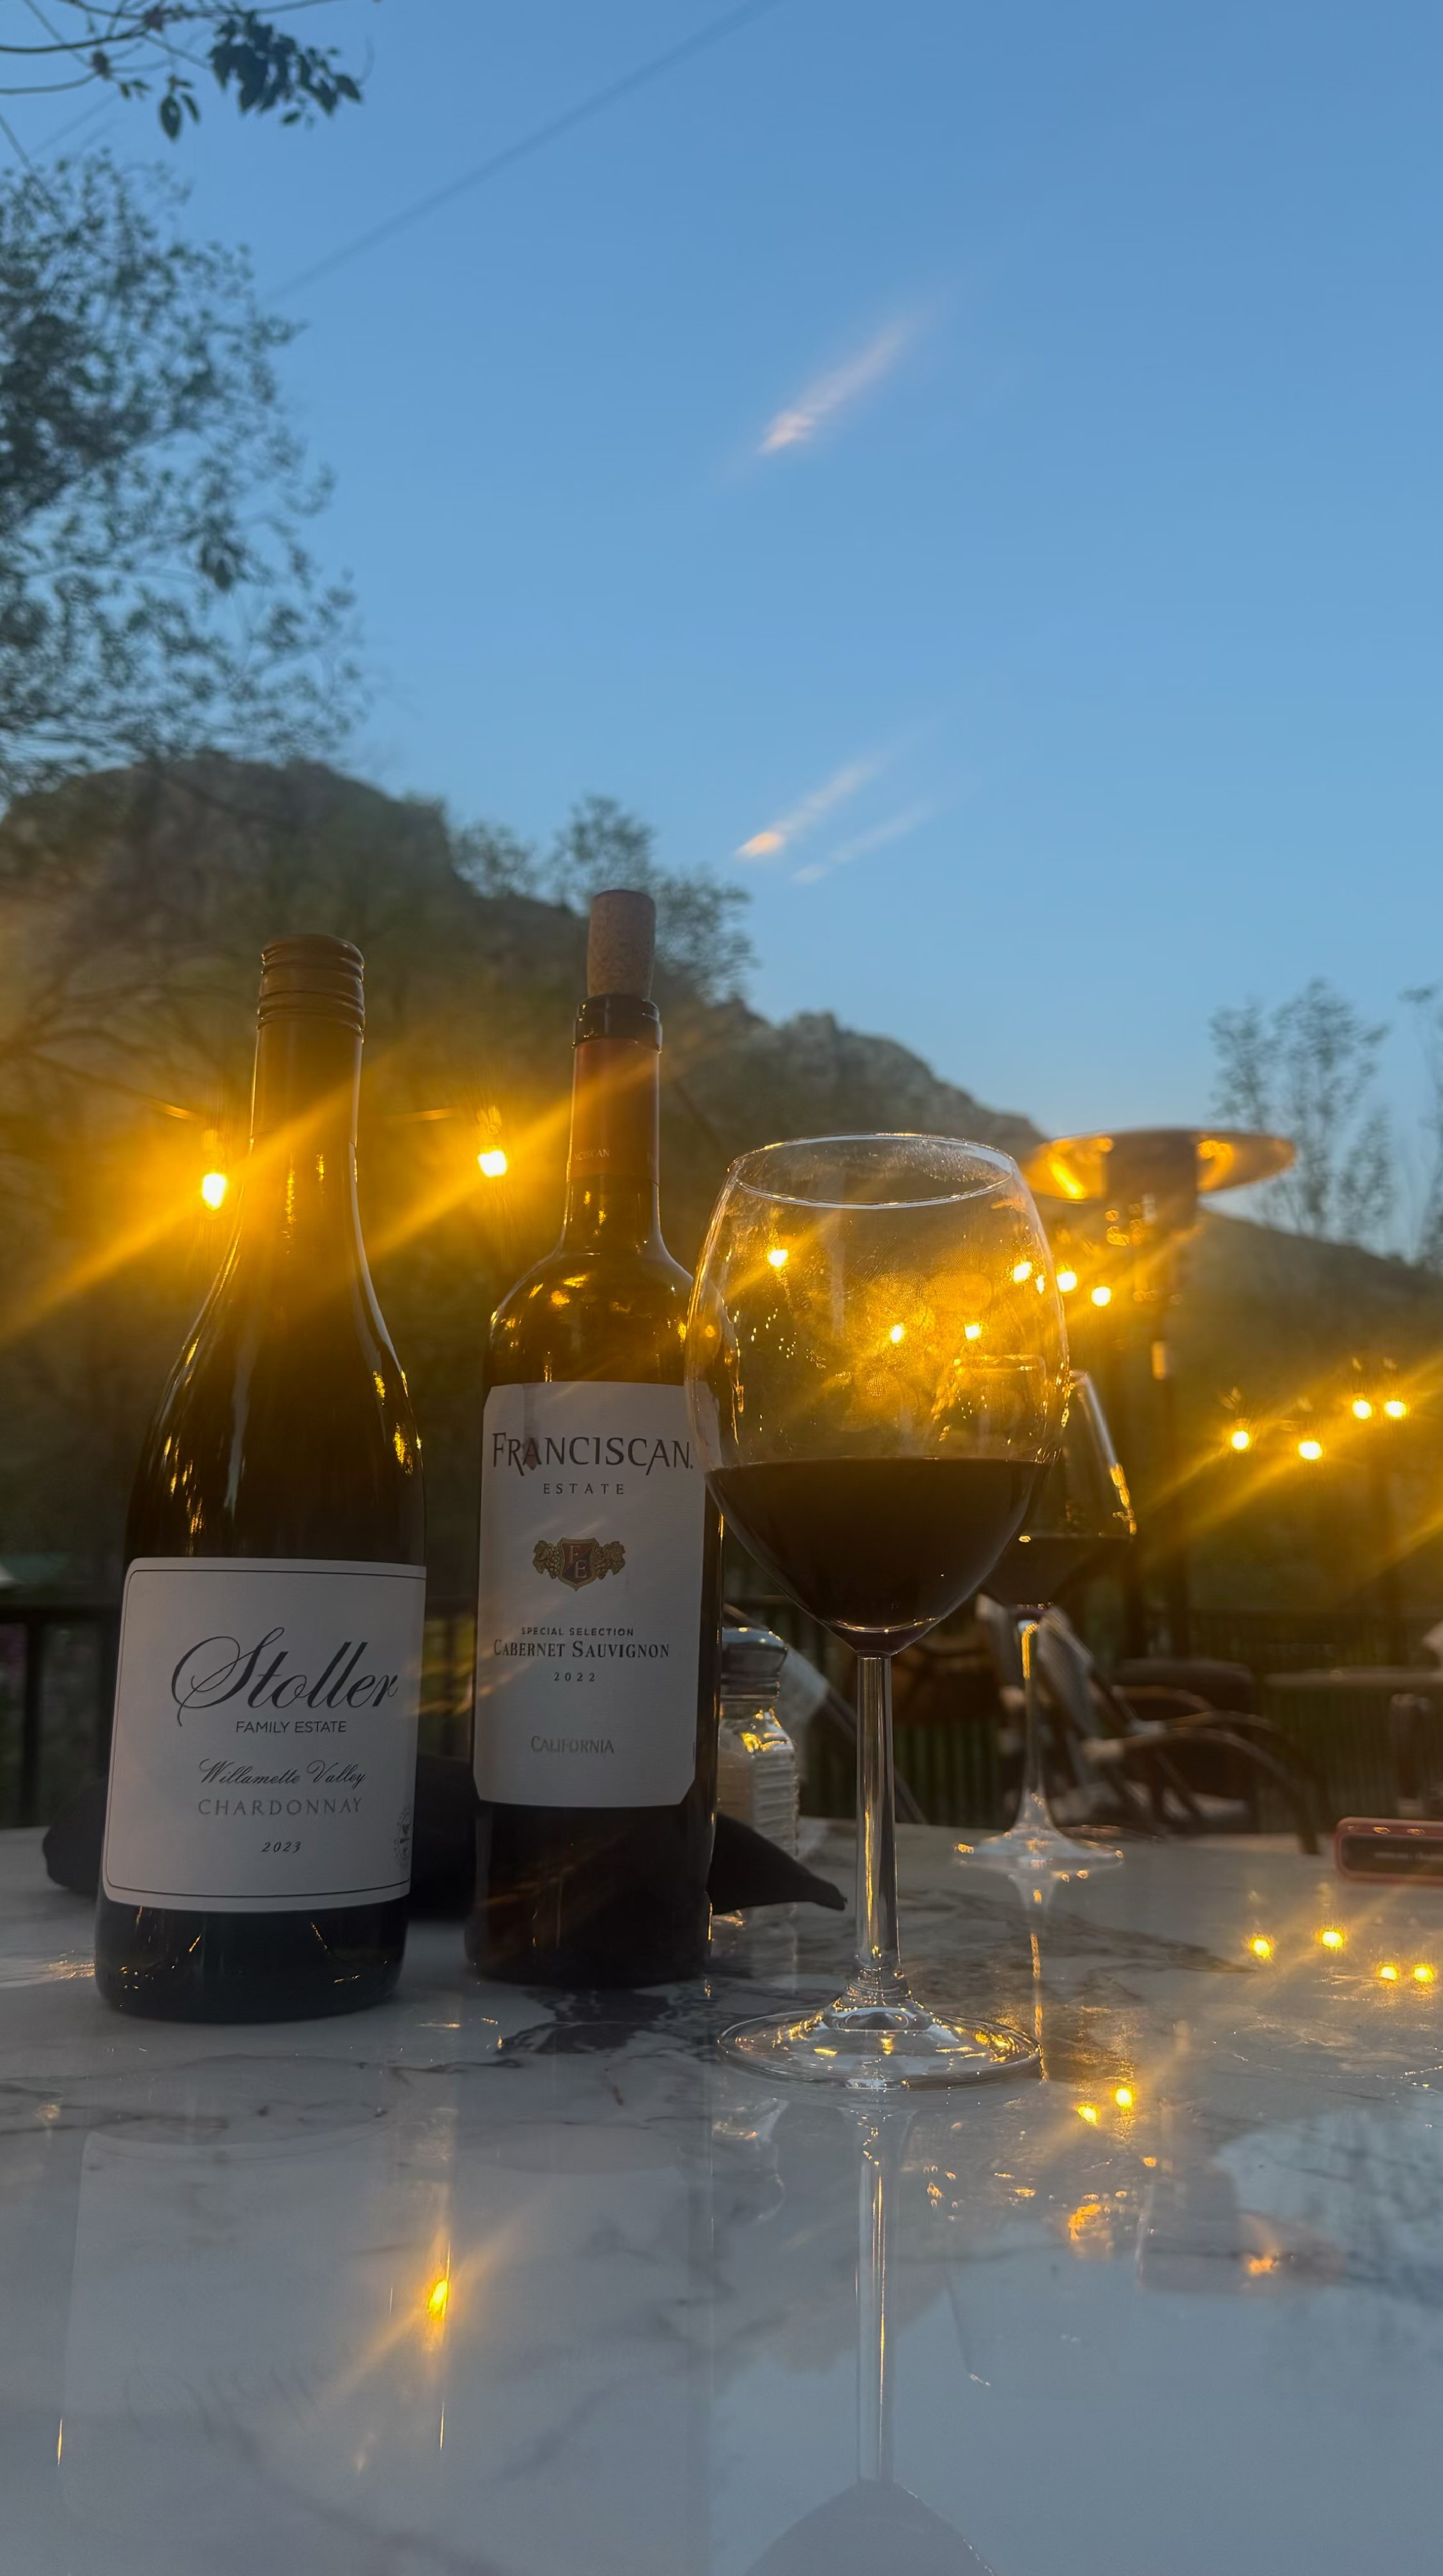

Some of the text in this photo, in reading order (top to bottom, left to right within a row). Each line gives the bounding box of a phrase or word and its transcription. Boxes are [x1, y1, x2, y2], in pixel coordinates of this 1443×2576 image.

[543, 1483, 624, 1495] ESTATE
[521, 1627, 634, 1637] SPECIAL SELECTION
[494, 1639, 670, 1658] CABERNET SAUVIGNON
[171, 1627, 399, 1727] Stoller
[554, 1672, 596, 1682] 2022
[236, 1721, 347, 1733] FAMILY ESTATE
[531, 1735, 614, 1754] CALIFORNIA
[199, 1758, 366, 1789] Willamette Valley
[198, 1798, 362, 1816] CHARDONNAY
[261, 1841, 302, 1853] 2023
